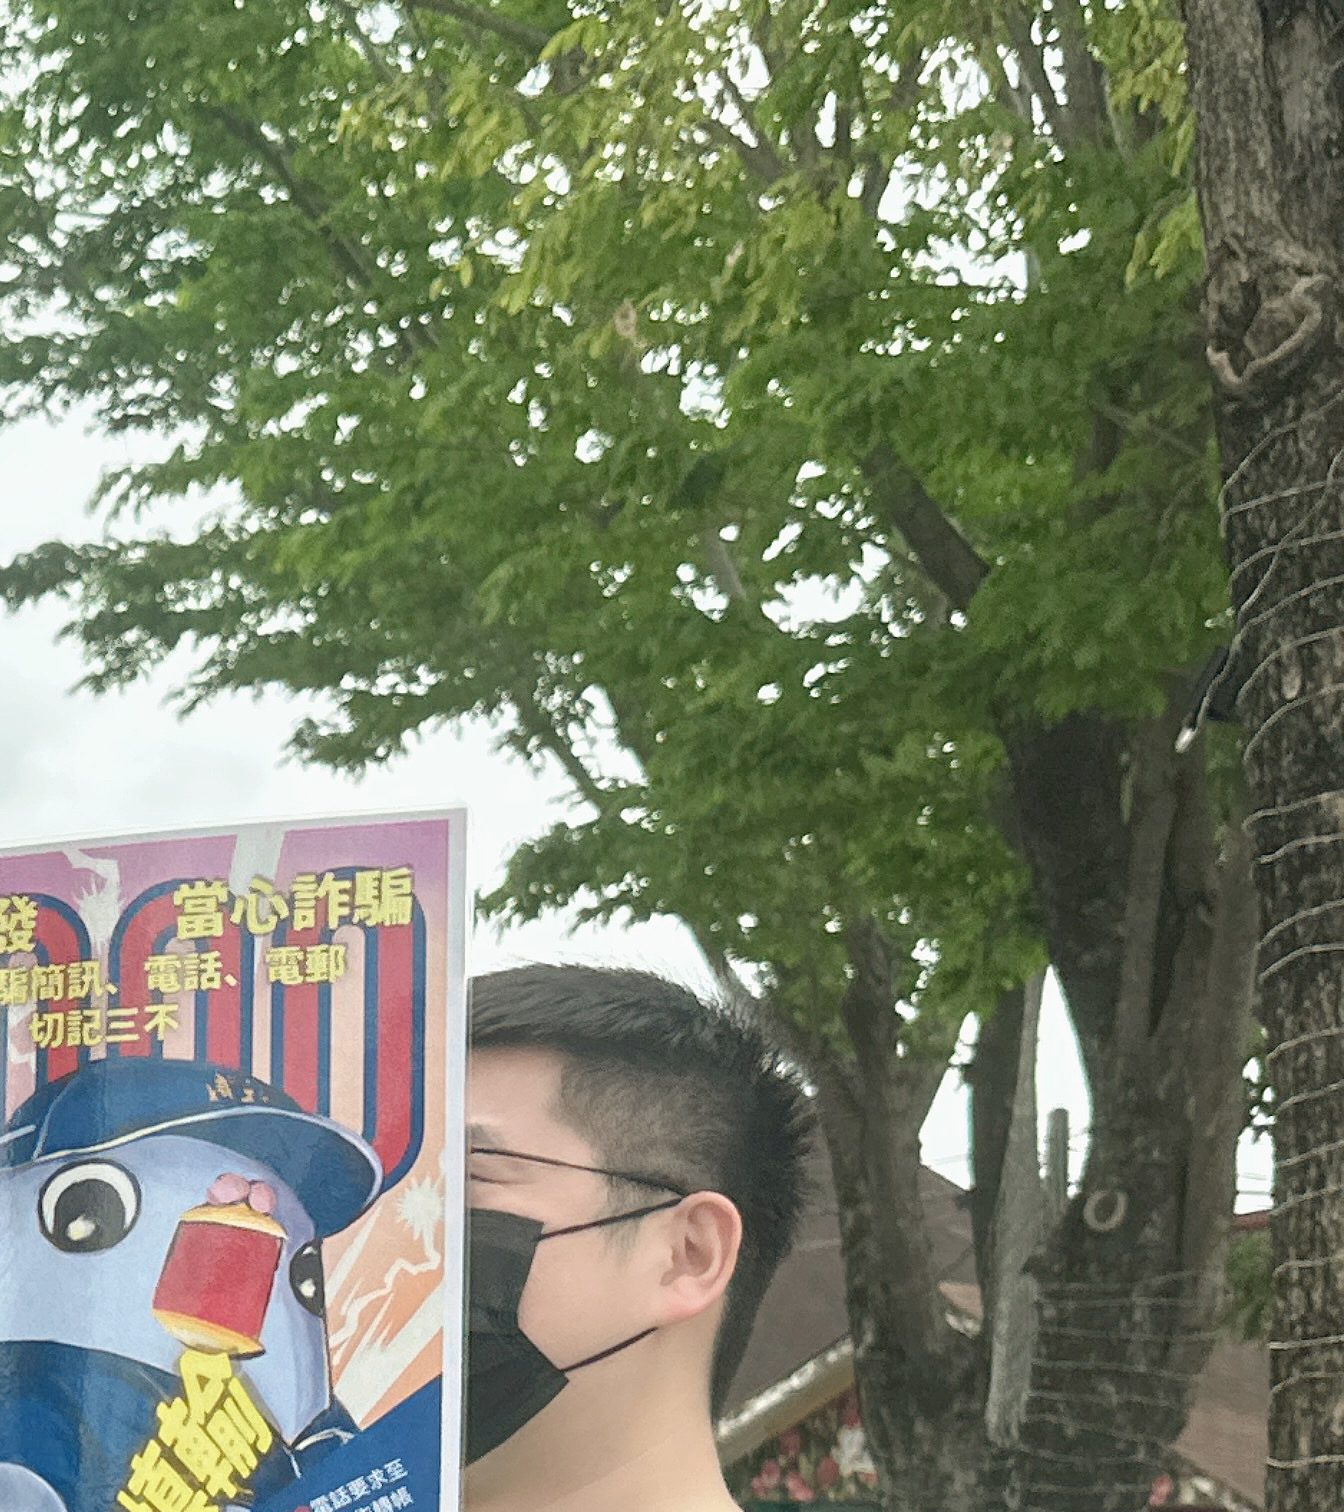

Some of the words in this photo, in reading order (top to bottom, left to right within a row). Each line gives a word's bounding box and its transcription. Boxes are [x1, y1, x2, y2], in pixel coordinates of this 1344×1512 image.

[173, 866, 414, 941] 當心詐騙
[265, 943, 347, 986] 電郵
[29, 1002, 182, 1049] 切記三不
